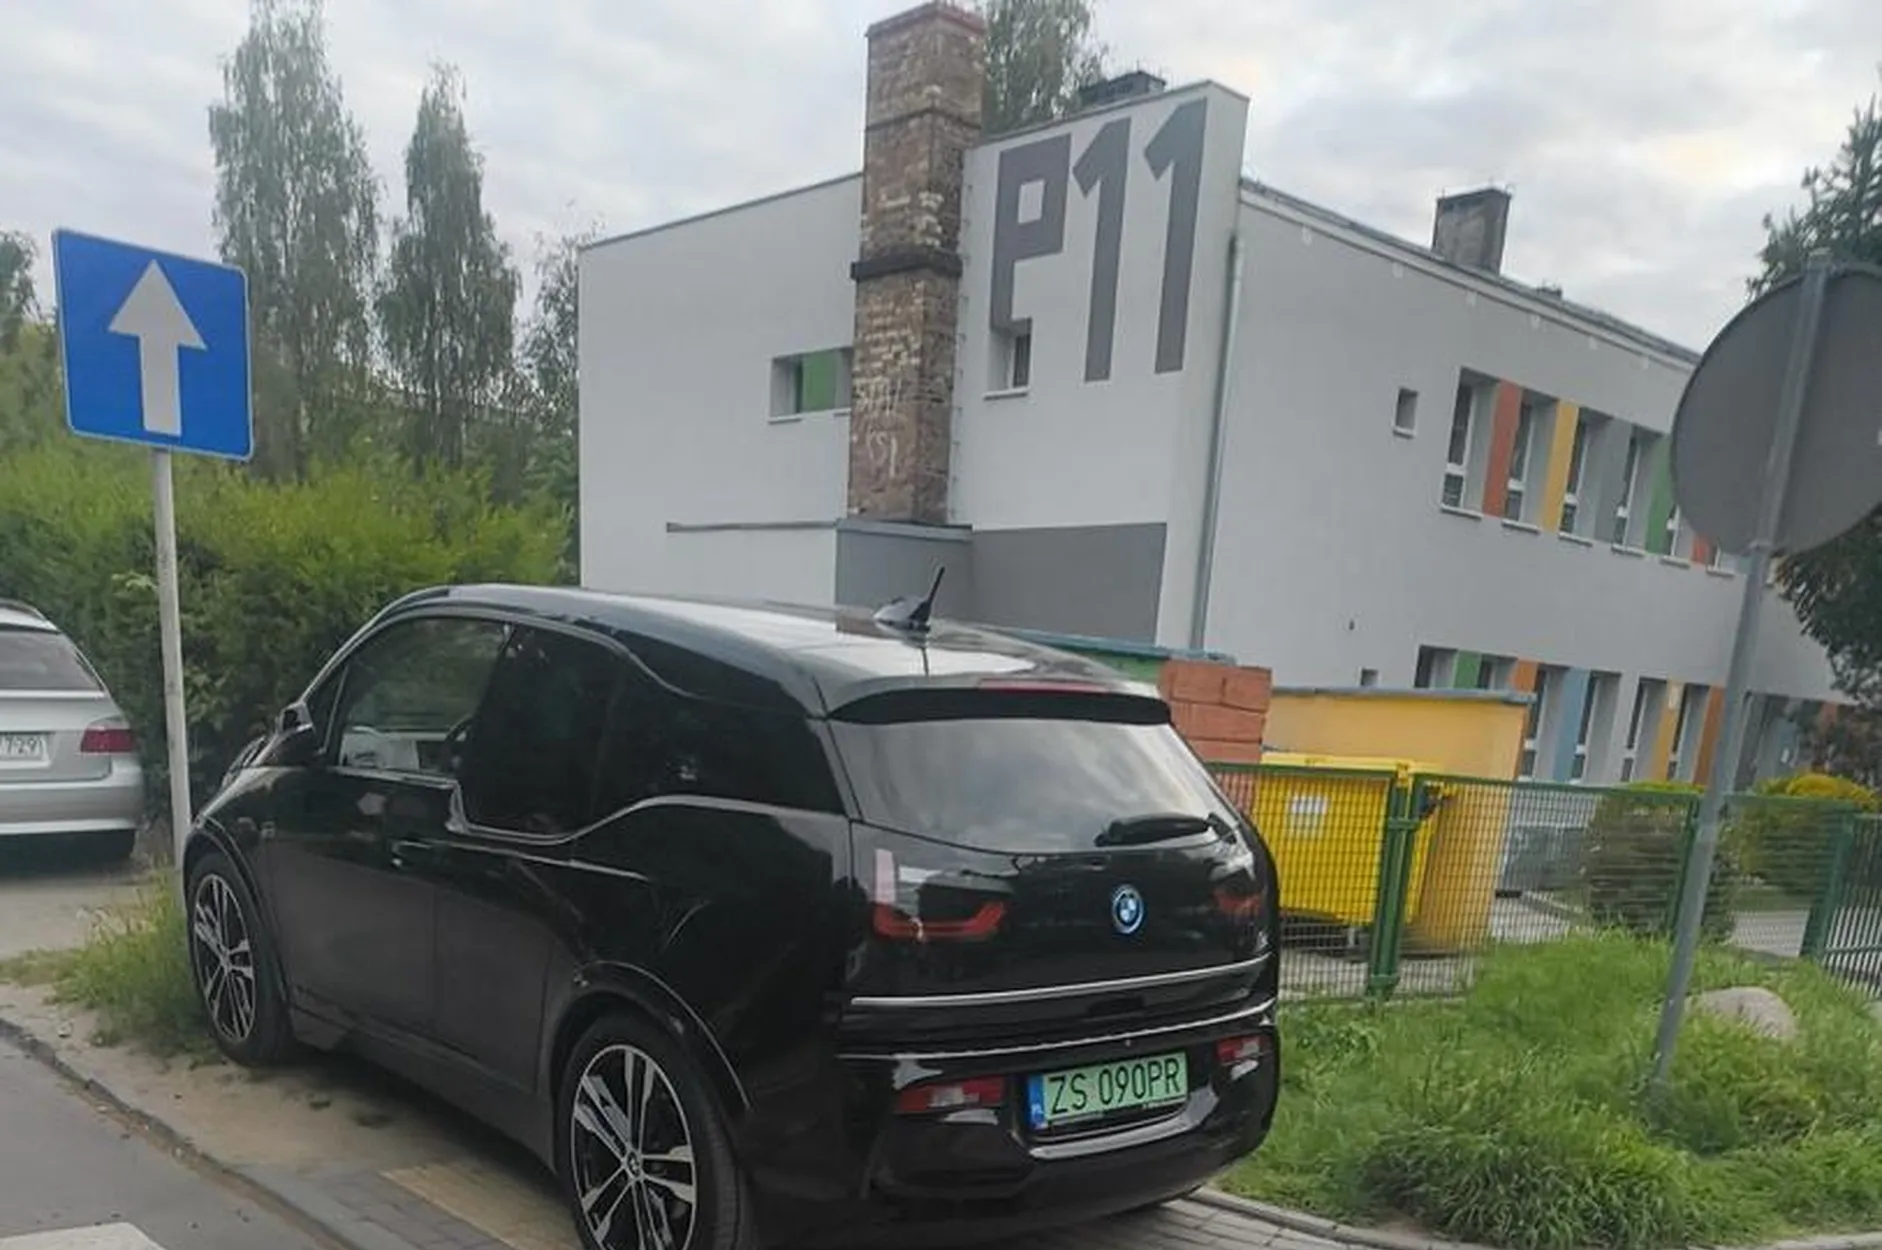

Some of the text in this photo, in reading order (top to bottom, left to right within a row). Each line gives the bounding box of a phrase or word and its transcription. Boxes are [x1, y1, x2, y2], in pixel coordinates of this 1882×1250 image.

[989, 97, 1207, 382] P11
[0, 735, 39, 754] 729
[1048, 1073, 1087, 1115] ZS
[1099, 1057, 1181, 1105] 090PR
